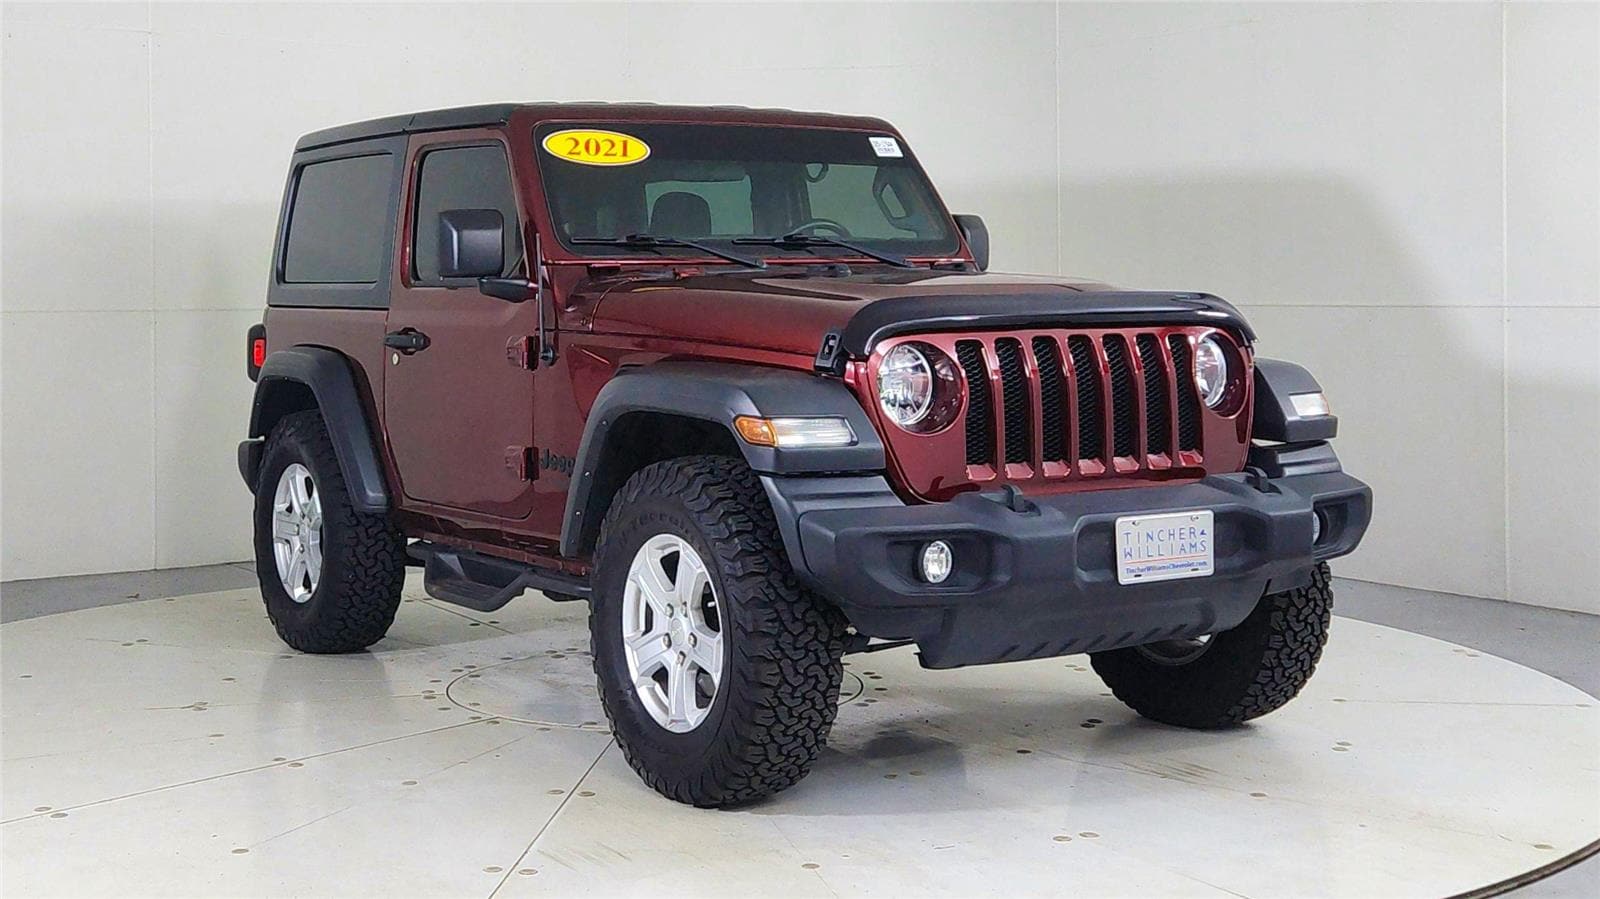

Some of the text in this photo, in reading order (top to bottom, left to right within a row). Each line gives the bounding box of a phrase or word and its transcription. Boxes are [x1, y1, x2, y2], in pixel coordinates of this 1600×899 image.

[565, 137, 630, 158] 2021
[1123, 526, 1198, 545] TINCHER
[1123, 540, 1207, 559] WILLIAMS
[1126, 561, 1208, 575] TincherWilliamsChevrolet.com
